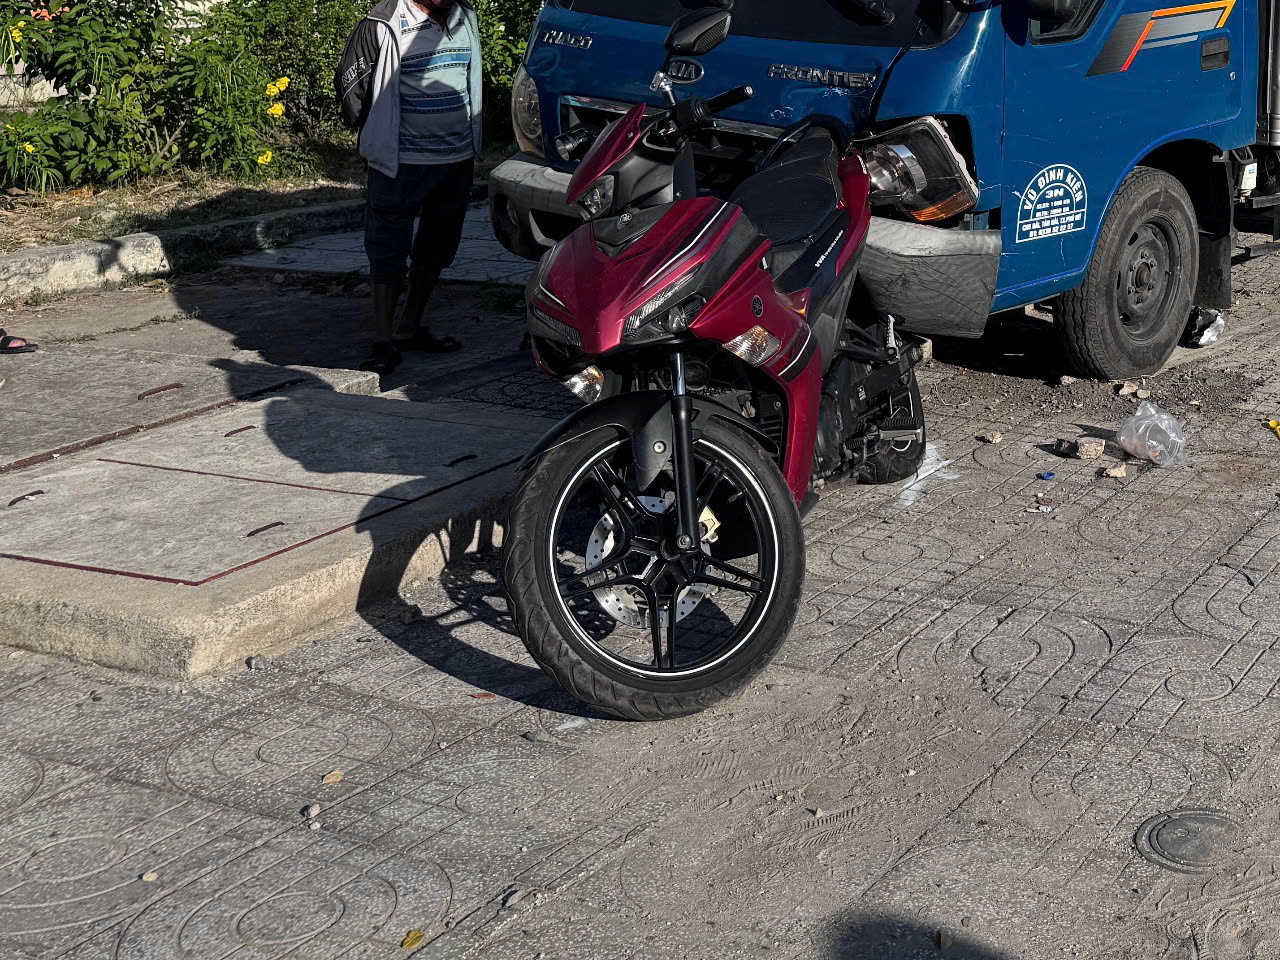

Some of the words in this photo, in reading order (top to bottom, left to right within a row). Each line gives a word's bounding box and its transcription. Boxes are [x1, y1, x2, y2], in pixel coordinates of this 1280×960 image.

[543, 30, 593, 50] THACO
[667, 62, 696, 79] KIA
[768, 64, 876, 87] FRONTIER
[1037, 168, 1064, 189] ĐÌNH
[1045, 188, 1064, 198] 3N
